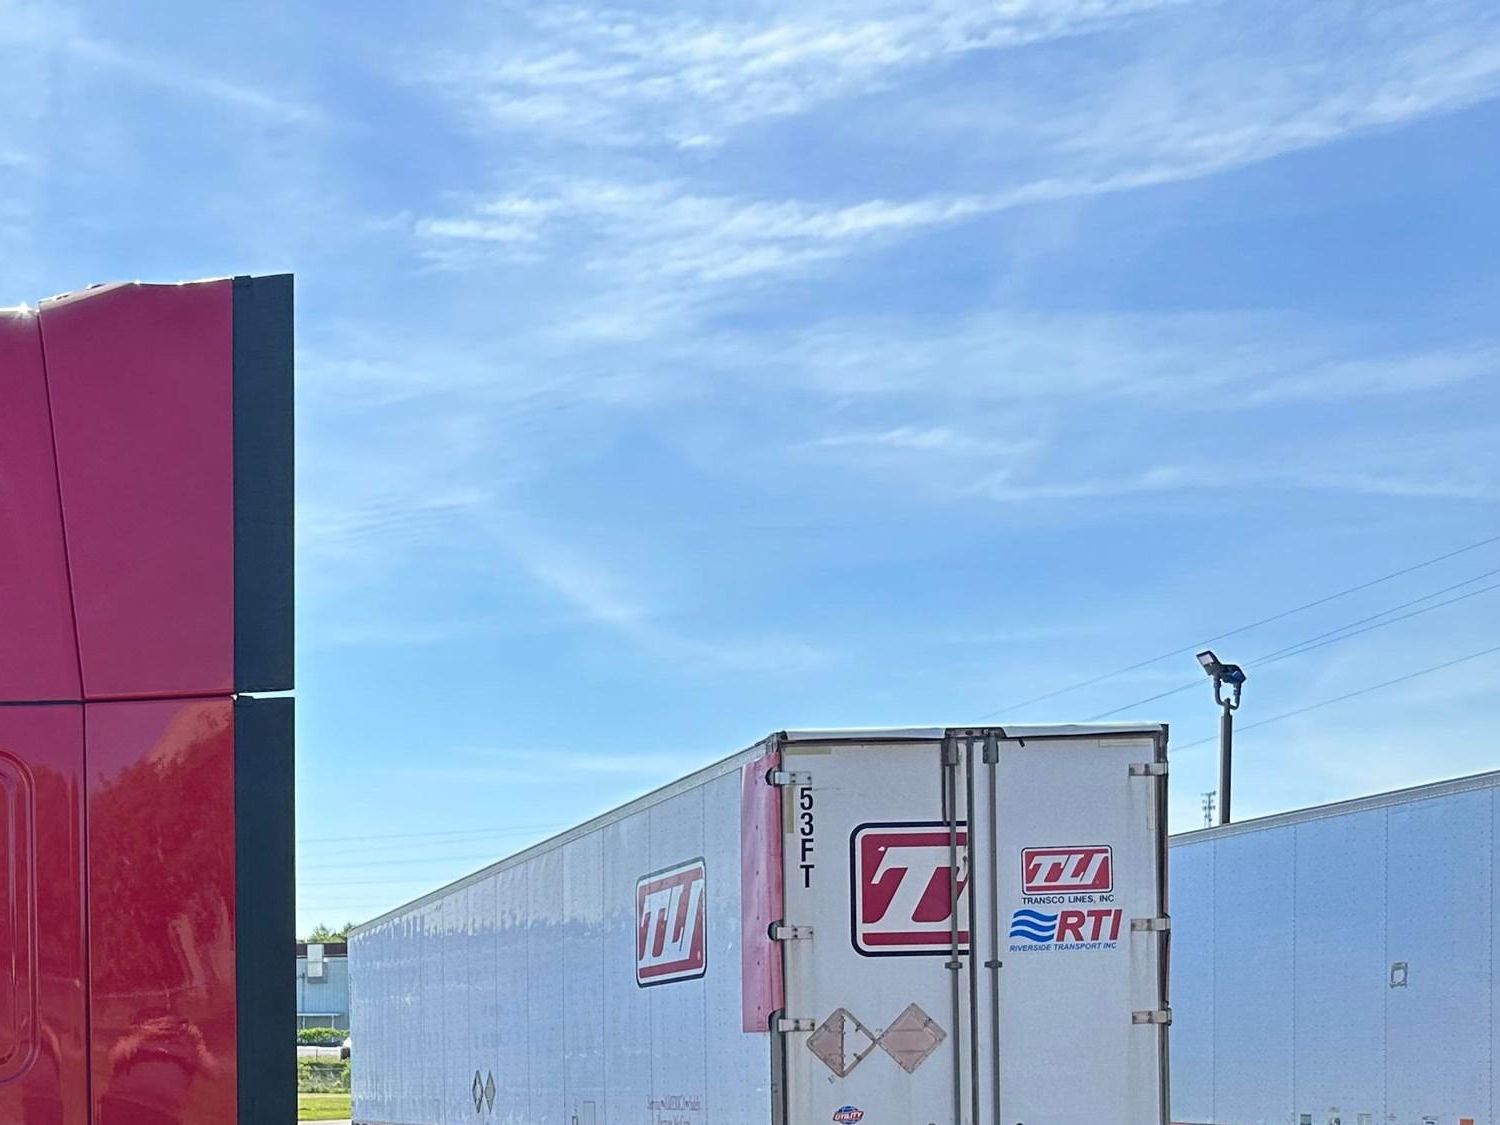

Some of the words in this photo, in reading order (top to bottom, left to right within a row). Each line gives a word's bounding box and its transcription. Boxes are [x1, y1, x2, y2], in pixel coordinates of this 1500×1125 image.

[800, 787, 814, 889] 53FT
[1022, 896, 1065, 905] TRANSCO
[1099, 894, 1115, 902] INC
[1056, 909, 1122, 942] RTI
[1009, 943, 1051, 952] RIVERSIDE
[1054, 943, 1101, 951] TRANSPORT
[834, 1111, 862, 1120] UTILITY
